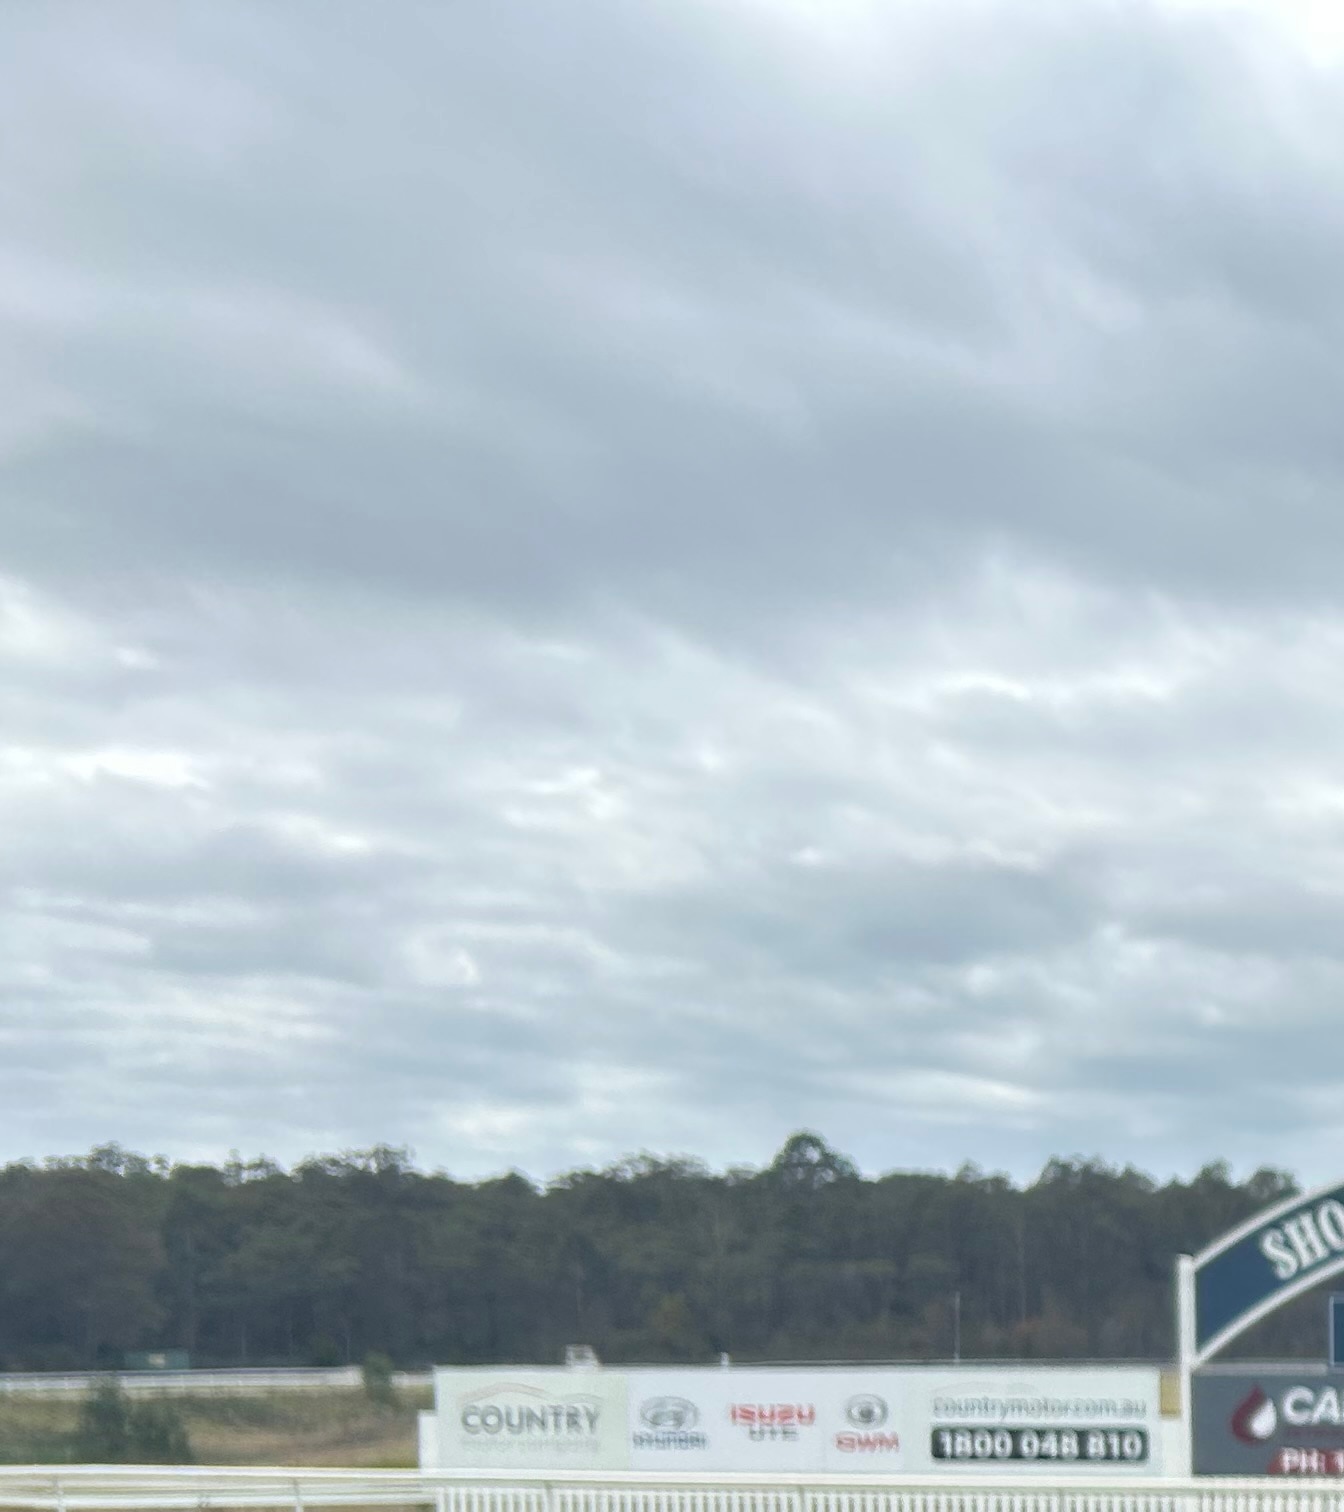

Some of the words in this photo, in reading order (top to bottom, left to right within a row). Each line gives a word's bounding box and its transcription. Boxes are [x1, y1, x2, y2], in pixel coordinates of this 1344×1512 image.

[460, 1403, 601, 1436] COUNTRY
[729, 1402, 817, 1426] ISUZU
[834, 1431, 900, 1454] GWM
[937, 1428, 1015, 1460] 1800
